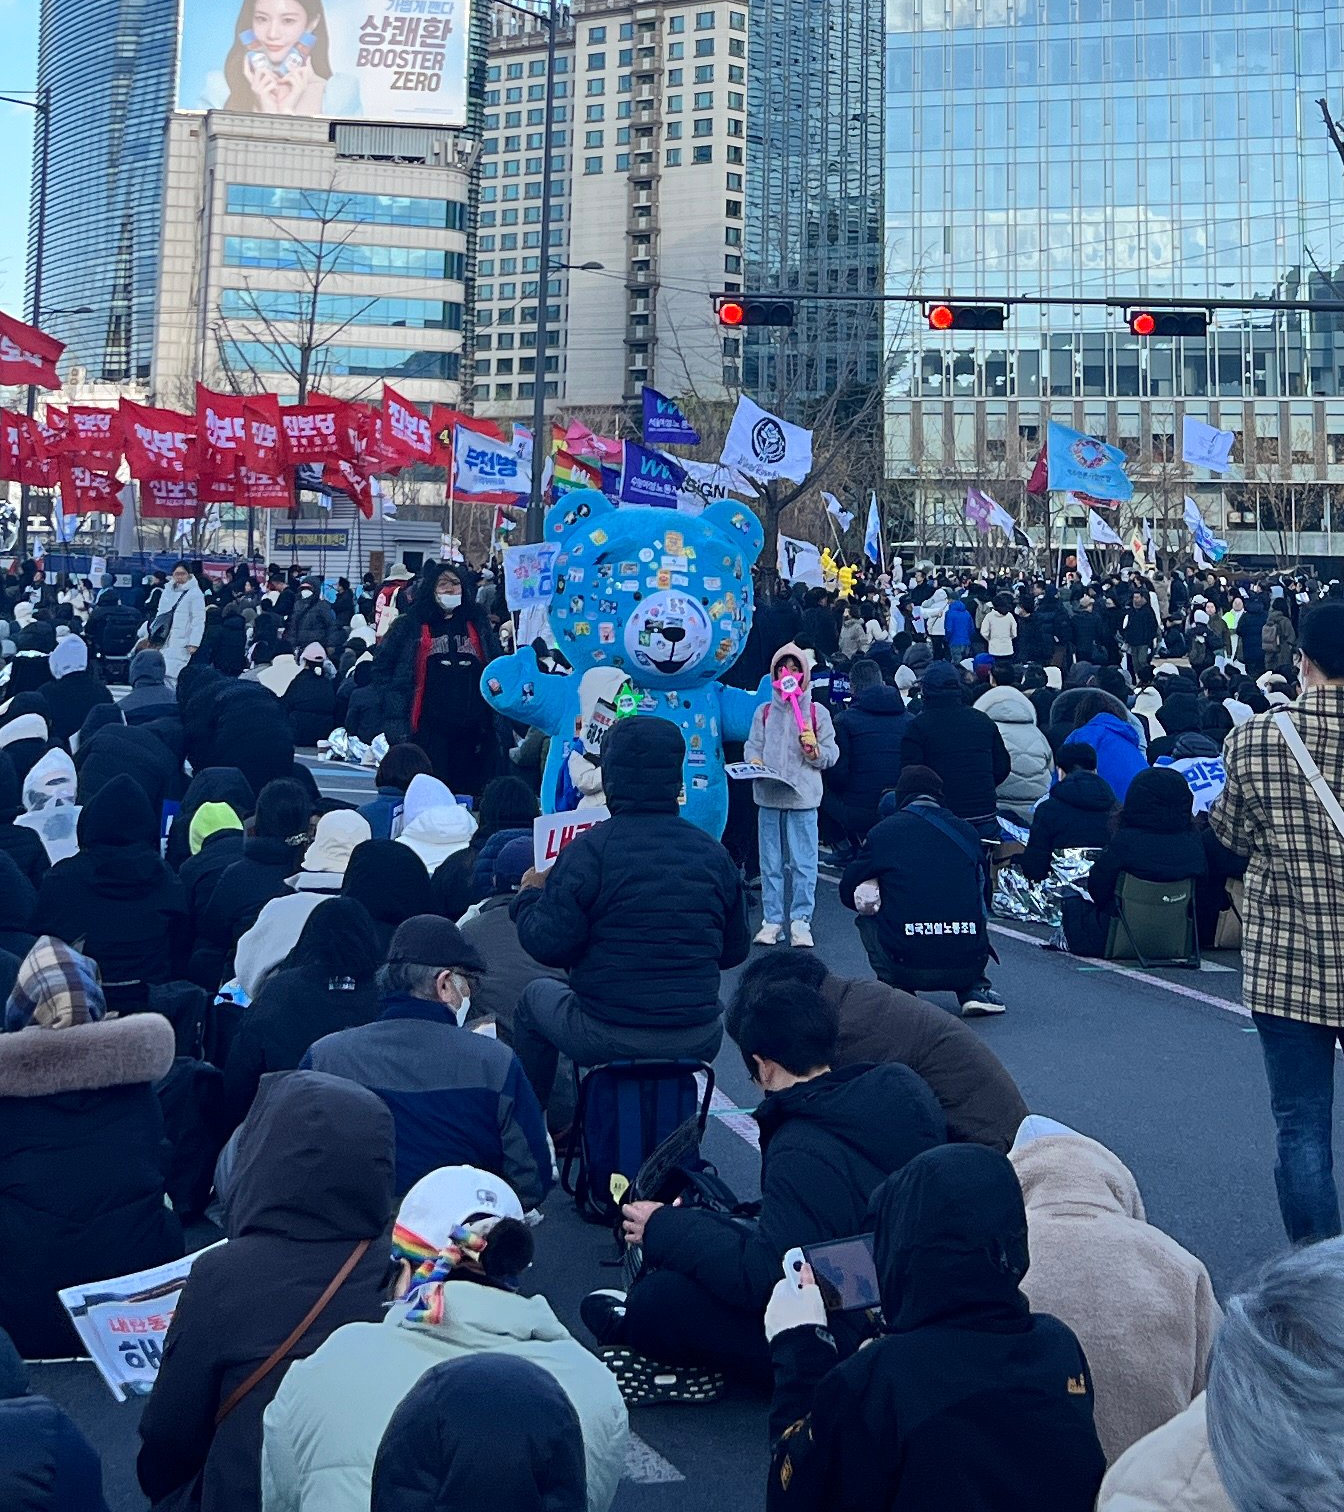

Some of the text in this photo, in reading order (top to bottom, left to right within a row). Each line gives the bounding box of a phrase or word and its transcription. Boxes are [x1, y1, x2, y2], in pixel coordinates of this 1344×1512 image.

[358, 14, 453, 49] 상쾌환
[356, 47, 446, 71] BOOSTER
[390, 71, 442, 92] ZERO
[283, 412, 336, 437] 진보당
[904, 921, 977, 936] 전국건설노동조합
